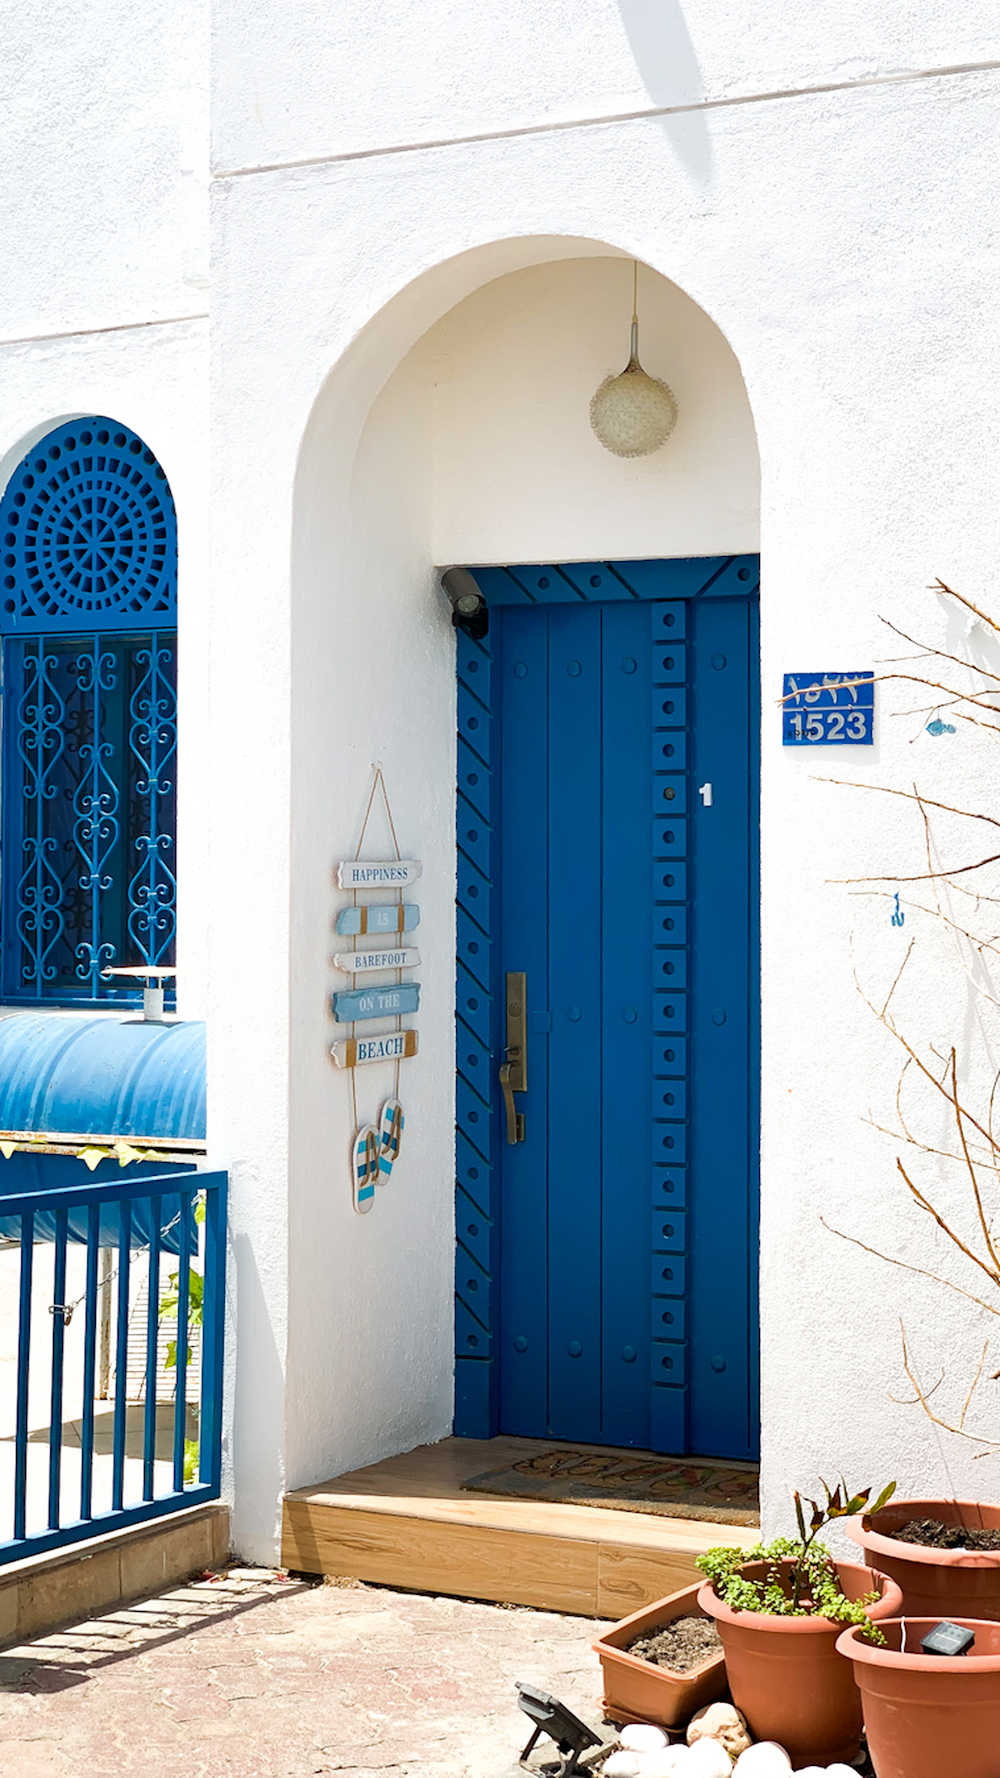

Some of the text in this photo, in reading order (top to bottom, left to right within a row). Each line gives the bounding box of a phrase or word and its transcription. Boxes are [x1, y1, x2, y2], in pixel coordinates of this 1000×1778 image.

[788, 675, 864, 705] ١٥٢٣
[790, 712, 867, 741] 1523
[699, 783, 712, 806] 1
[352, 867, 408, 881] HAPPINESS
[377, 912, 389, 926] IS
[355, 953, 406, 968] BAREFOOT
[359, 993, 400, 1012] ON THE
[358, 1037, 404, 1060] BEACH
